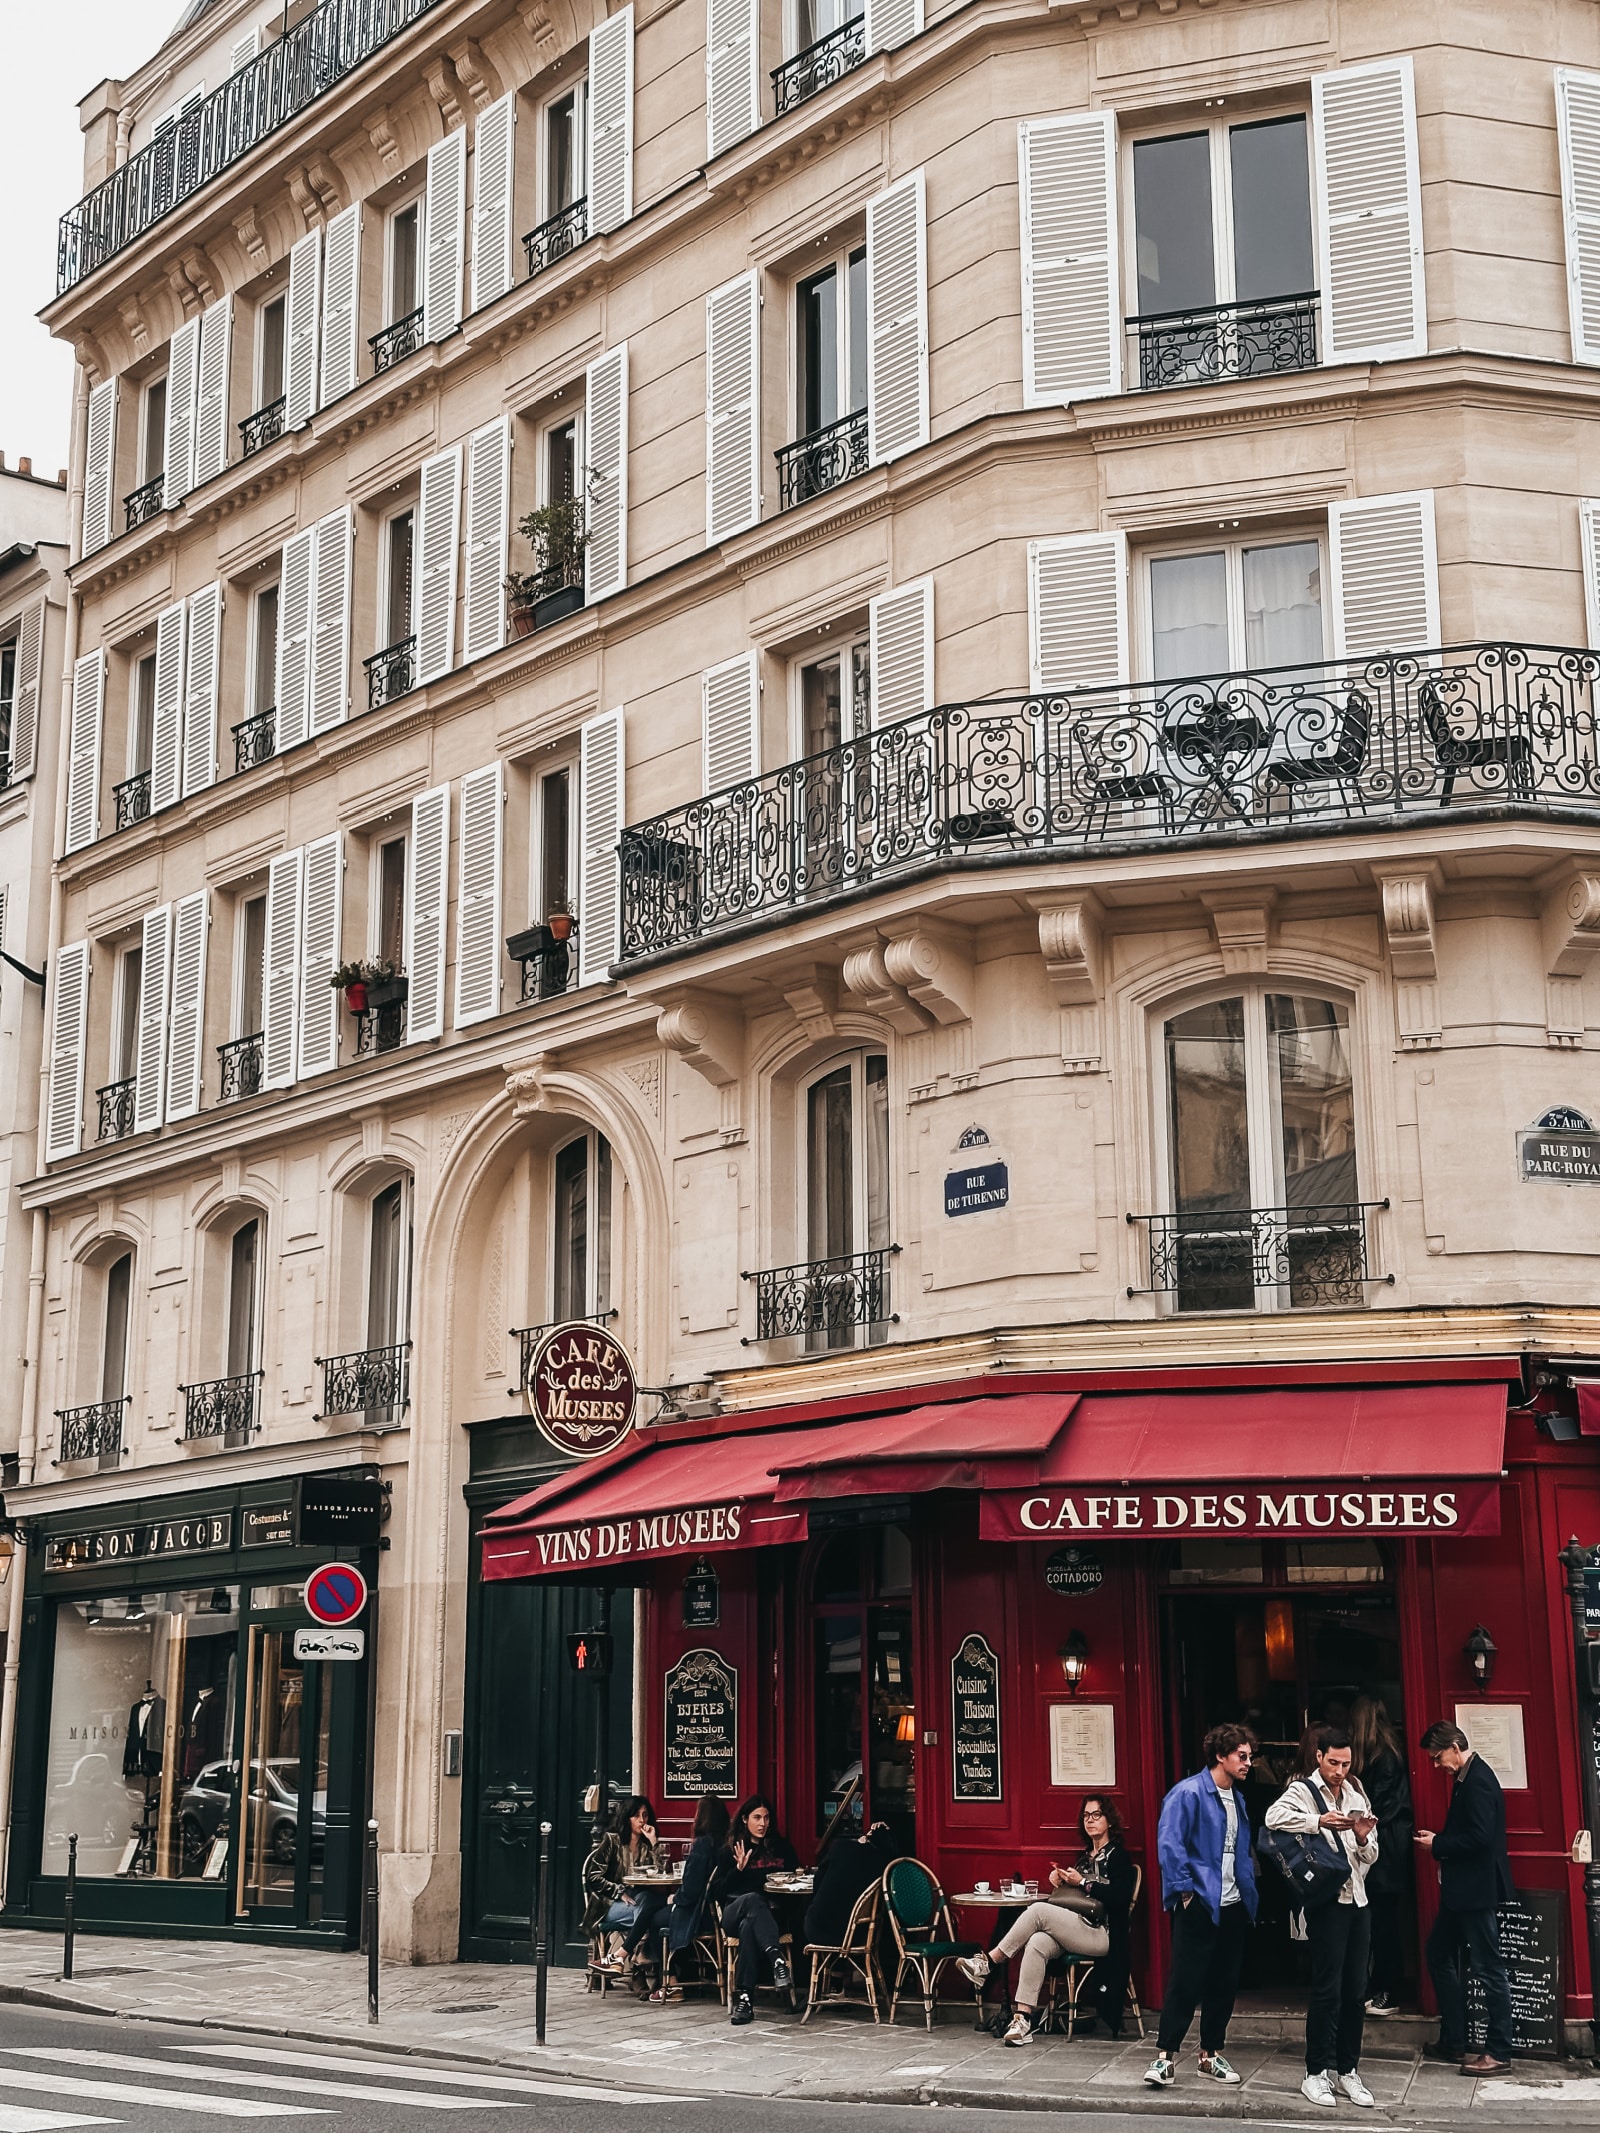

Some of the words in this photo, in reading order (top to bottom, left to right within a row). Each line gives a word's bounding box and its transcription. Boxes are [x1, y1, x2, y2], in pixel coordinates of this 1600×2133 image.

[1540, 1144, 1568, 1157] RUE
[1572, 1146, 1591, 1158] DU
[966, 1175, 985, 1189] RUE
[948, 1197, 960, 1210] DE
[961, 1188, 1006, 1207] TURENNE
[546, 1338, 619, 1373] CAFE
[568, 1367, 602, 1391] des
[545, 1389, 626, 1422] MUSEES
[306, 1504, 342, 1512] MAISON
[1019, 1496, 1143, 1530] CAFE
[1152, 1494, 1247, 1528] DES
[1256, 1492, 1459, 1527] MUSEES
[249, 1513, 282, 1526] Costumes
[150, 1521, 222, 1551] JACOB
[536, 1527, 592, 1565] VINS
[596, 1521, 632, 1558] DE
[636, 1505, 742, 1552] MUSEES
[1046, 1571, 1102, 1584] COSTADORO
[957, 1675, 988, 1695] Cuisine
[964, 1700, 996, 1719] Maison
[143, 1724, 198, 1739] ACOB
[676, 1724, 724, 1734] Pression
[705, 1746, 734, 1757] Chocolat
[667, 1771, 702, 1781] Salades
[962, 1763, 992, 1778] Viandes
